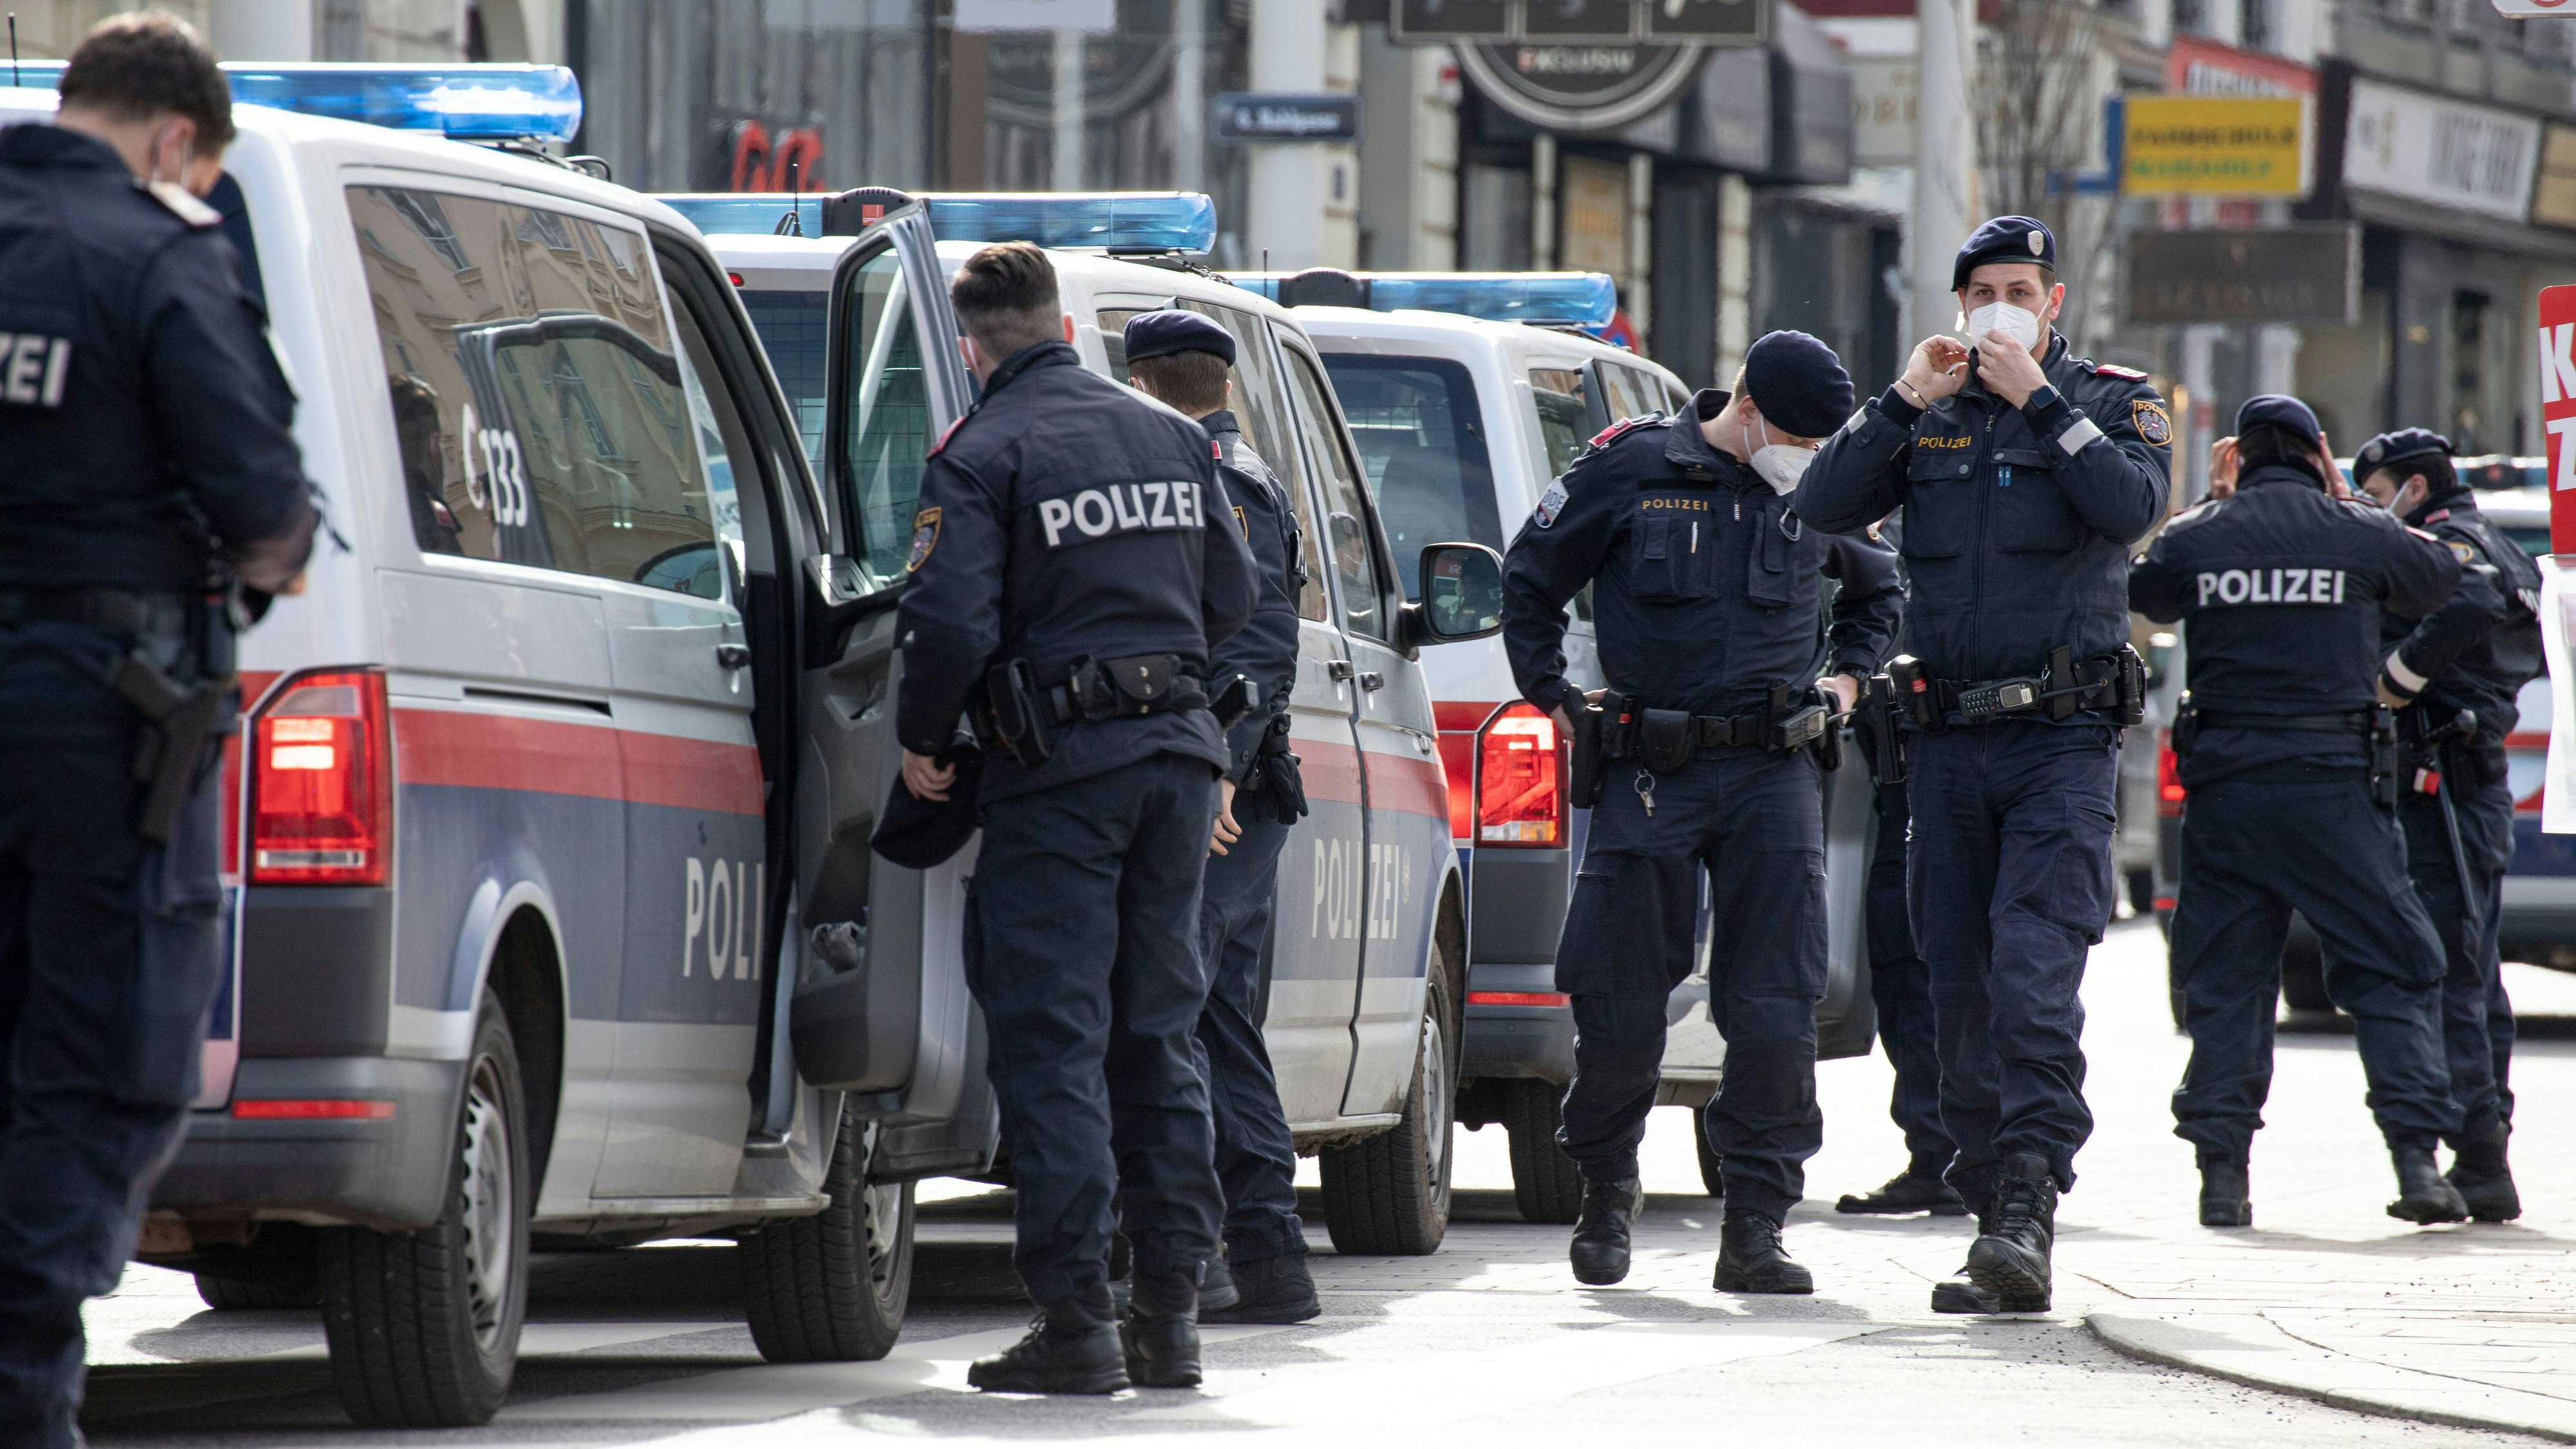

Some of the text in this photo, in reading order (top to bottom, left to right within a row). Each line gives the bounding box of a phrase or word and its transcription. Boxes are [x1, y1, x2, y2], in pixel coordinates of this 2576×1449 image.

[0, 332, 73, 408] EI
[1918, 435, 1972, 449] POLIZEI
[1039, 481, 1206, 547] POLIZEI
[1642, 498, 1709, 511] POLIZEI
[2197, 569, 2345, 607] POLIZEI
[683, 857, 764, 981] POLI
[1312, 838, 1399, 940] POLIZEI
